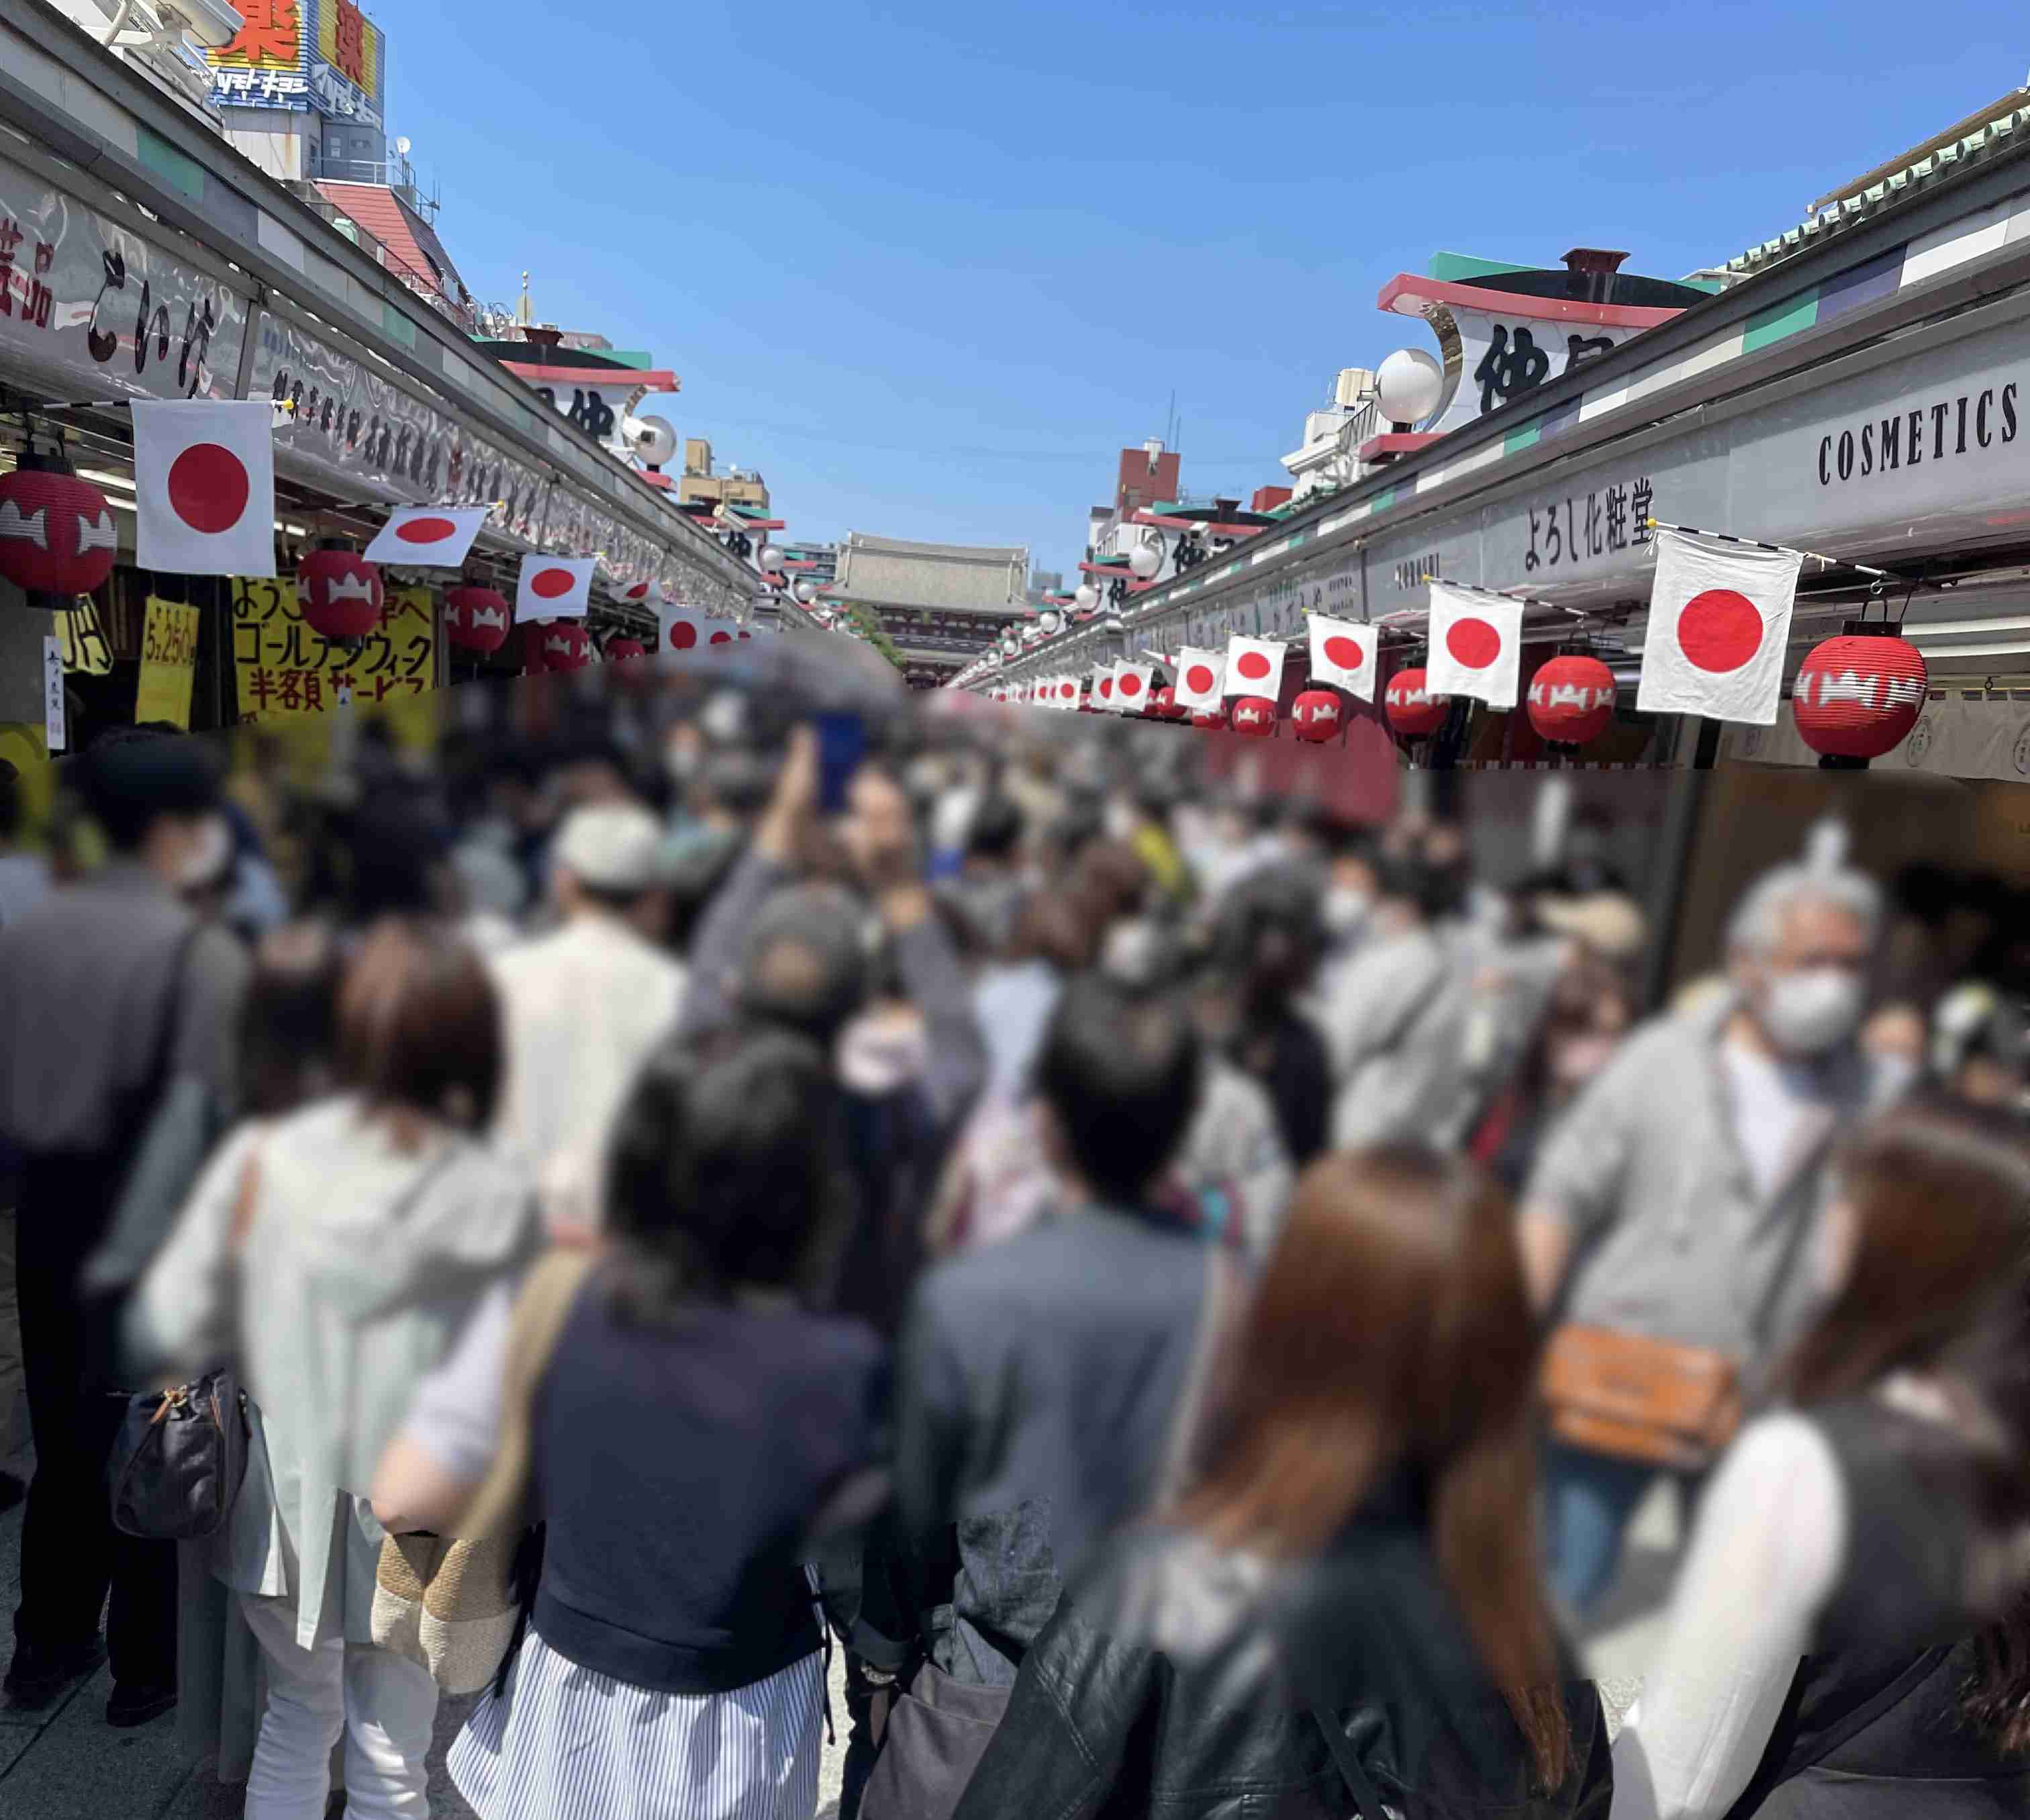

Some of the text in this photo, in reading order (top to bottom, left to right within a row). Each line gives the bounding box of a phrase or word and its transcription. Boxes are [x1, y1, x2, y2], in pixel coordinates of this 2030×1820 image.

[211, 66, 309, 98] ツモトキヨシ
[1819, 381, 2017, 486] COSMETICS
[1525, 477, 1653, 571] よろし化粧堂
